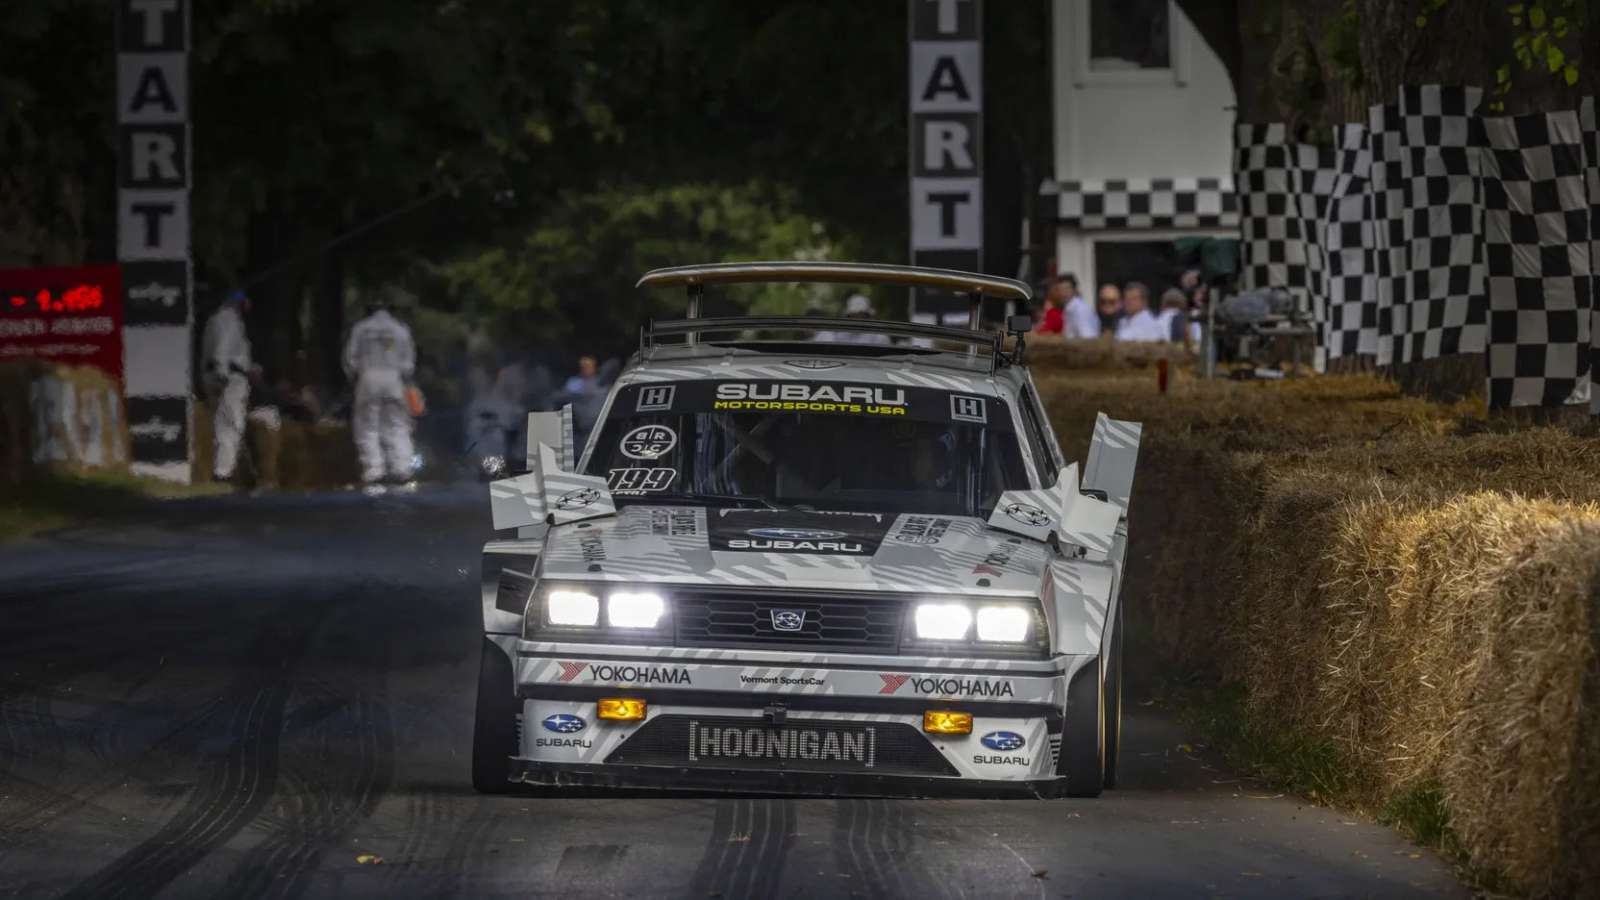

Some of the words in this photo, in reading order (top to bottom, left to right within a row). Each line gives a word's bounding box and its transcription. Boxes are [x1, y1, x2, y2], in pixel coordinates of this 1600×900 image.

[715, 383, 906, 406] SUBARU
[714, 401, 862, 413] MOTORSPORTS
[867, 405, 905, 415] USA
[607, 467, 677, 491] 199
[728, 539, 863, 552] SUBARU
[590, 665, 692, 685] YOKOHAMA
[740, 675, 778, 684] Vermont
[780, 676, 825, 686] SportsCar
[911, 678, 1014, 697] YOKOHAMA
[535, 737, 592, 748] SUBARU
[973, 755, 1030, 767] SUBARU
